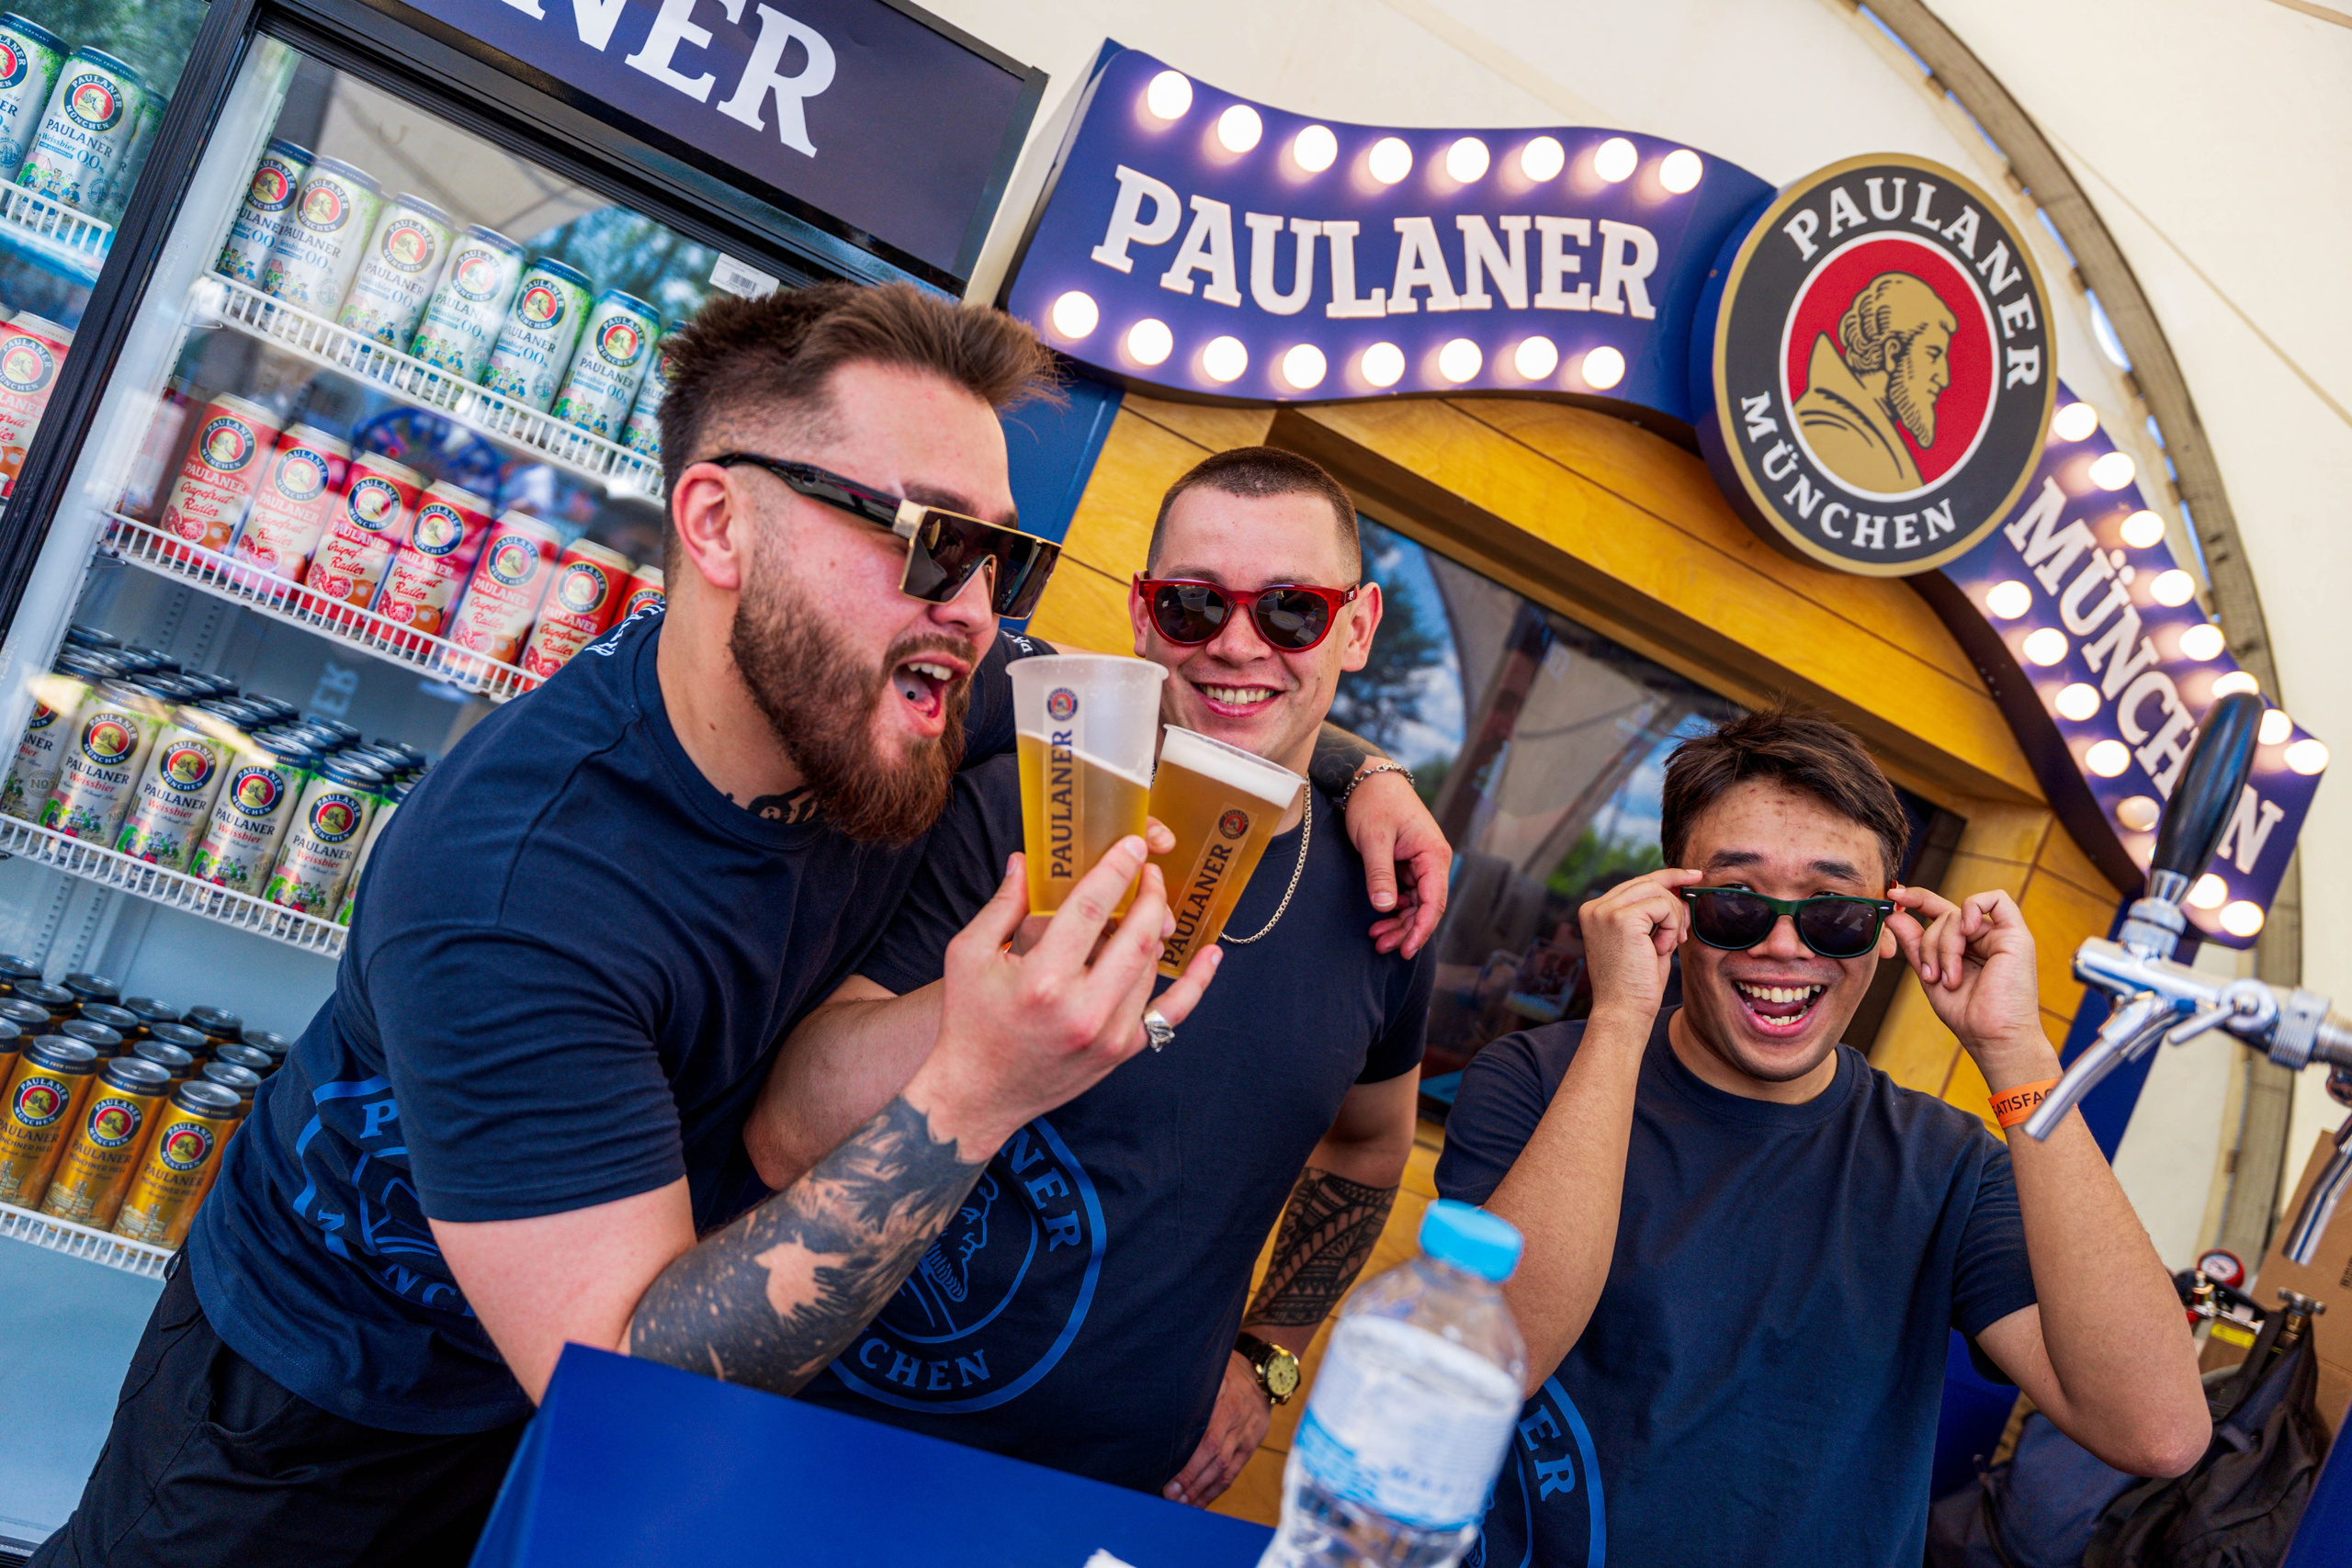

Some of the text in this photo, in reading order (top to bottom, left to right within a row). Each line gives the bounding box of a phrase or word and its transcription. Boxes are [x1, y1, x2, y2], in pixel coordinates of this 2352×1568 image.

[72, 74, 122, 108] PAULANER
[46, 118, 113, 158] PAULANER
[304, 178, 349, 210] PAULANER
[285, 226, 341, 259] PAULANER
[389, 220, 435, 250] PAULANER
[1091, 164, 1660, 320] PAULANER
[364, 263, 424, 297] PAULANER
[524, 278, 565, 308] PAULANER
[1783, 176, 2041, 389] PAULANER
[604, 317, 644, 345] PAULANER
[3, 337, 52, 368] PAULANER
[579, 357, 635, 389] PAULANER
[208, 418, 254, 447] PAULANER
[185, 462, 245, 493] PAULANER
[282, 449, 328, 479] PAULANER
[1741, 390, 1957, 549] MÜNCHEN
[258, 491, 319, 523] PAULANER
[355, 479, 399, 508] PAULANER
[420, 504, 462, 534] PAULANER
[331, 522, 390, 553] PAULANER
[398, 547, 454, 579] PAULANER
[565, 563, 606, 591] PAULANER
[473, 577, 530, 608] PAULANER
[544, 604, 598, 635] PAULANER
[2003, 476, 2285, 874] MÜNCHN
[88, 713, 138, 740] PAULANER
[167, 740, 216, 768] PAULANER
[65, 755, 130, 785] PAULANER
[68, 770, 117, 794] Weissbier
[237, 765, 284, 794] PAULANER
[143, 783, 208, 811] PAULANER
[147, 798, 194, 820] Weissbier
[316, 794, 362, 819] PAULANER
[1051, 729, 1073, 879] PAULANER
[215, 807, 276, 837] PAULANER
[218, 822, 263, 844] Weissbier
[292, 834, 353, 861] PAULANER
[297, 849, 341, 870] Weissbier
[1161, 843, 1233, 967] PAULANER
[20, 1077, 69, 1101] PAULANER
[95, 1099, 141, 1122] PAULANER
[167, 1122, 213, 1146] PAULANER
[72, 1139, 132, 1165] PAULANER
[144, 1162, 204, 1187] PAULANER
